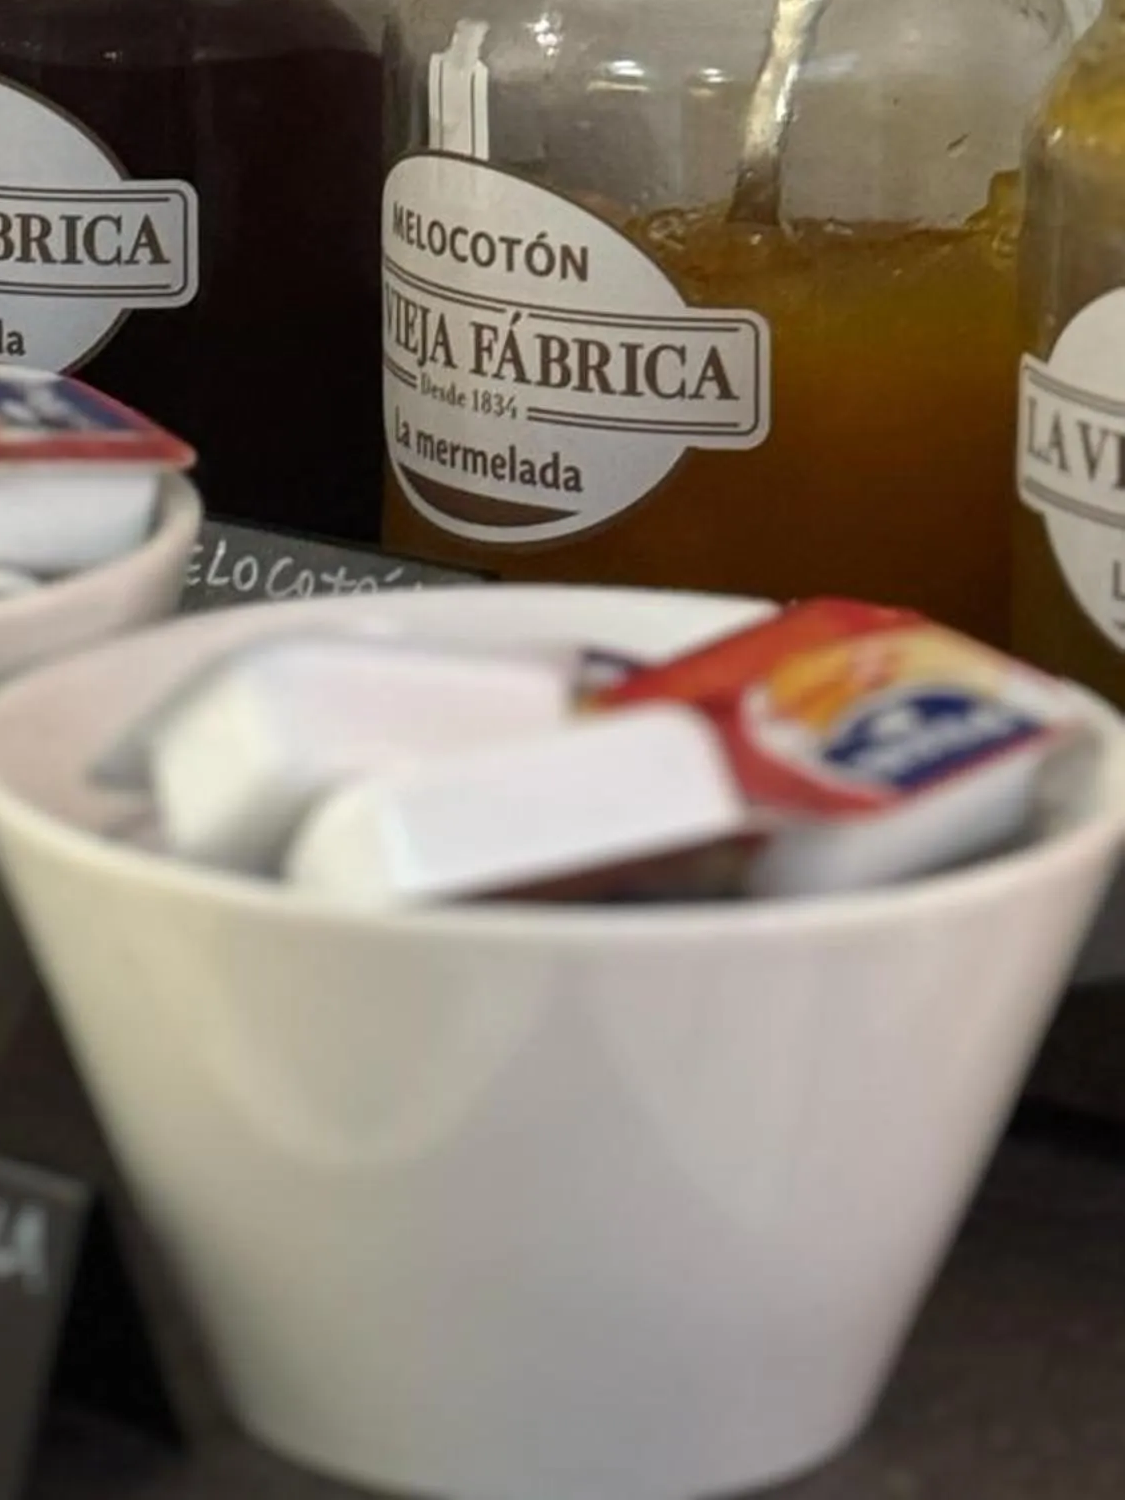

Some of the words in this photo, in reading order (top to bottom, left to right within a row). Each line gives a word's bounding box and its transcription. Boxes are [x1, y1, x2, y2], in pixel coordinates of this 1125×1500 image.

[391, 201, 590, 283] MELOCOTÓN
[384, 280, 459, 370] VIEJA
[469, 311, 740, 402] FÁBRICA
[420, 372, 466, 408] Desde
[472, 388, 519, 420] 1834
[394, 405, 412, 449] La
[416, 430, 584, 494] mermelada
